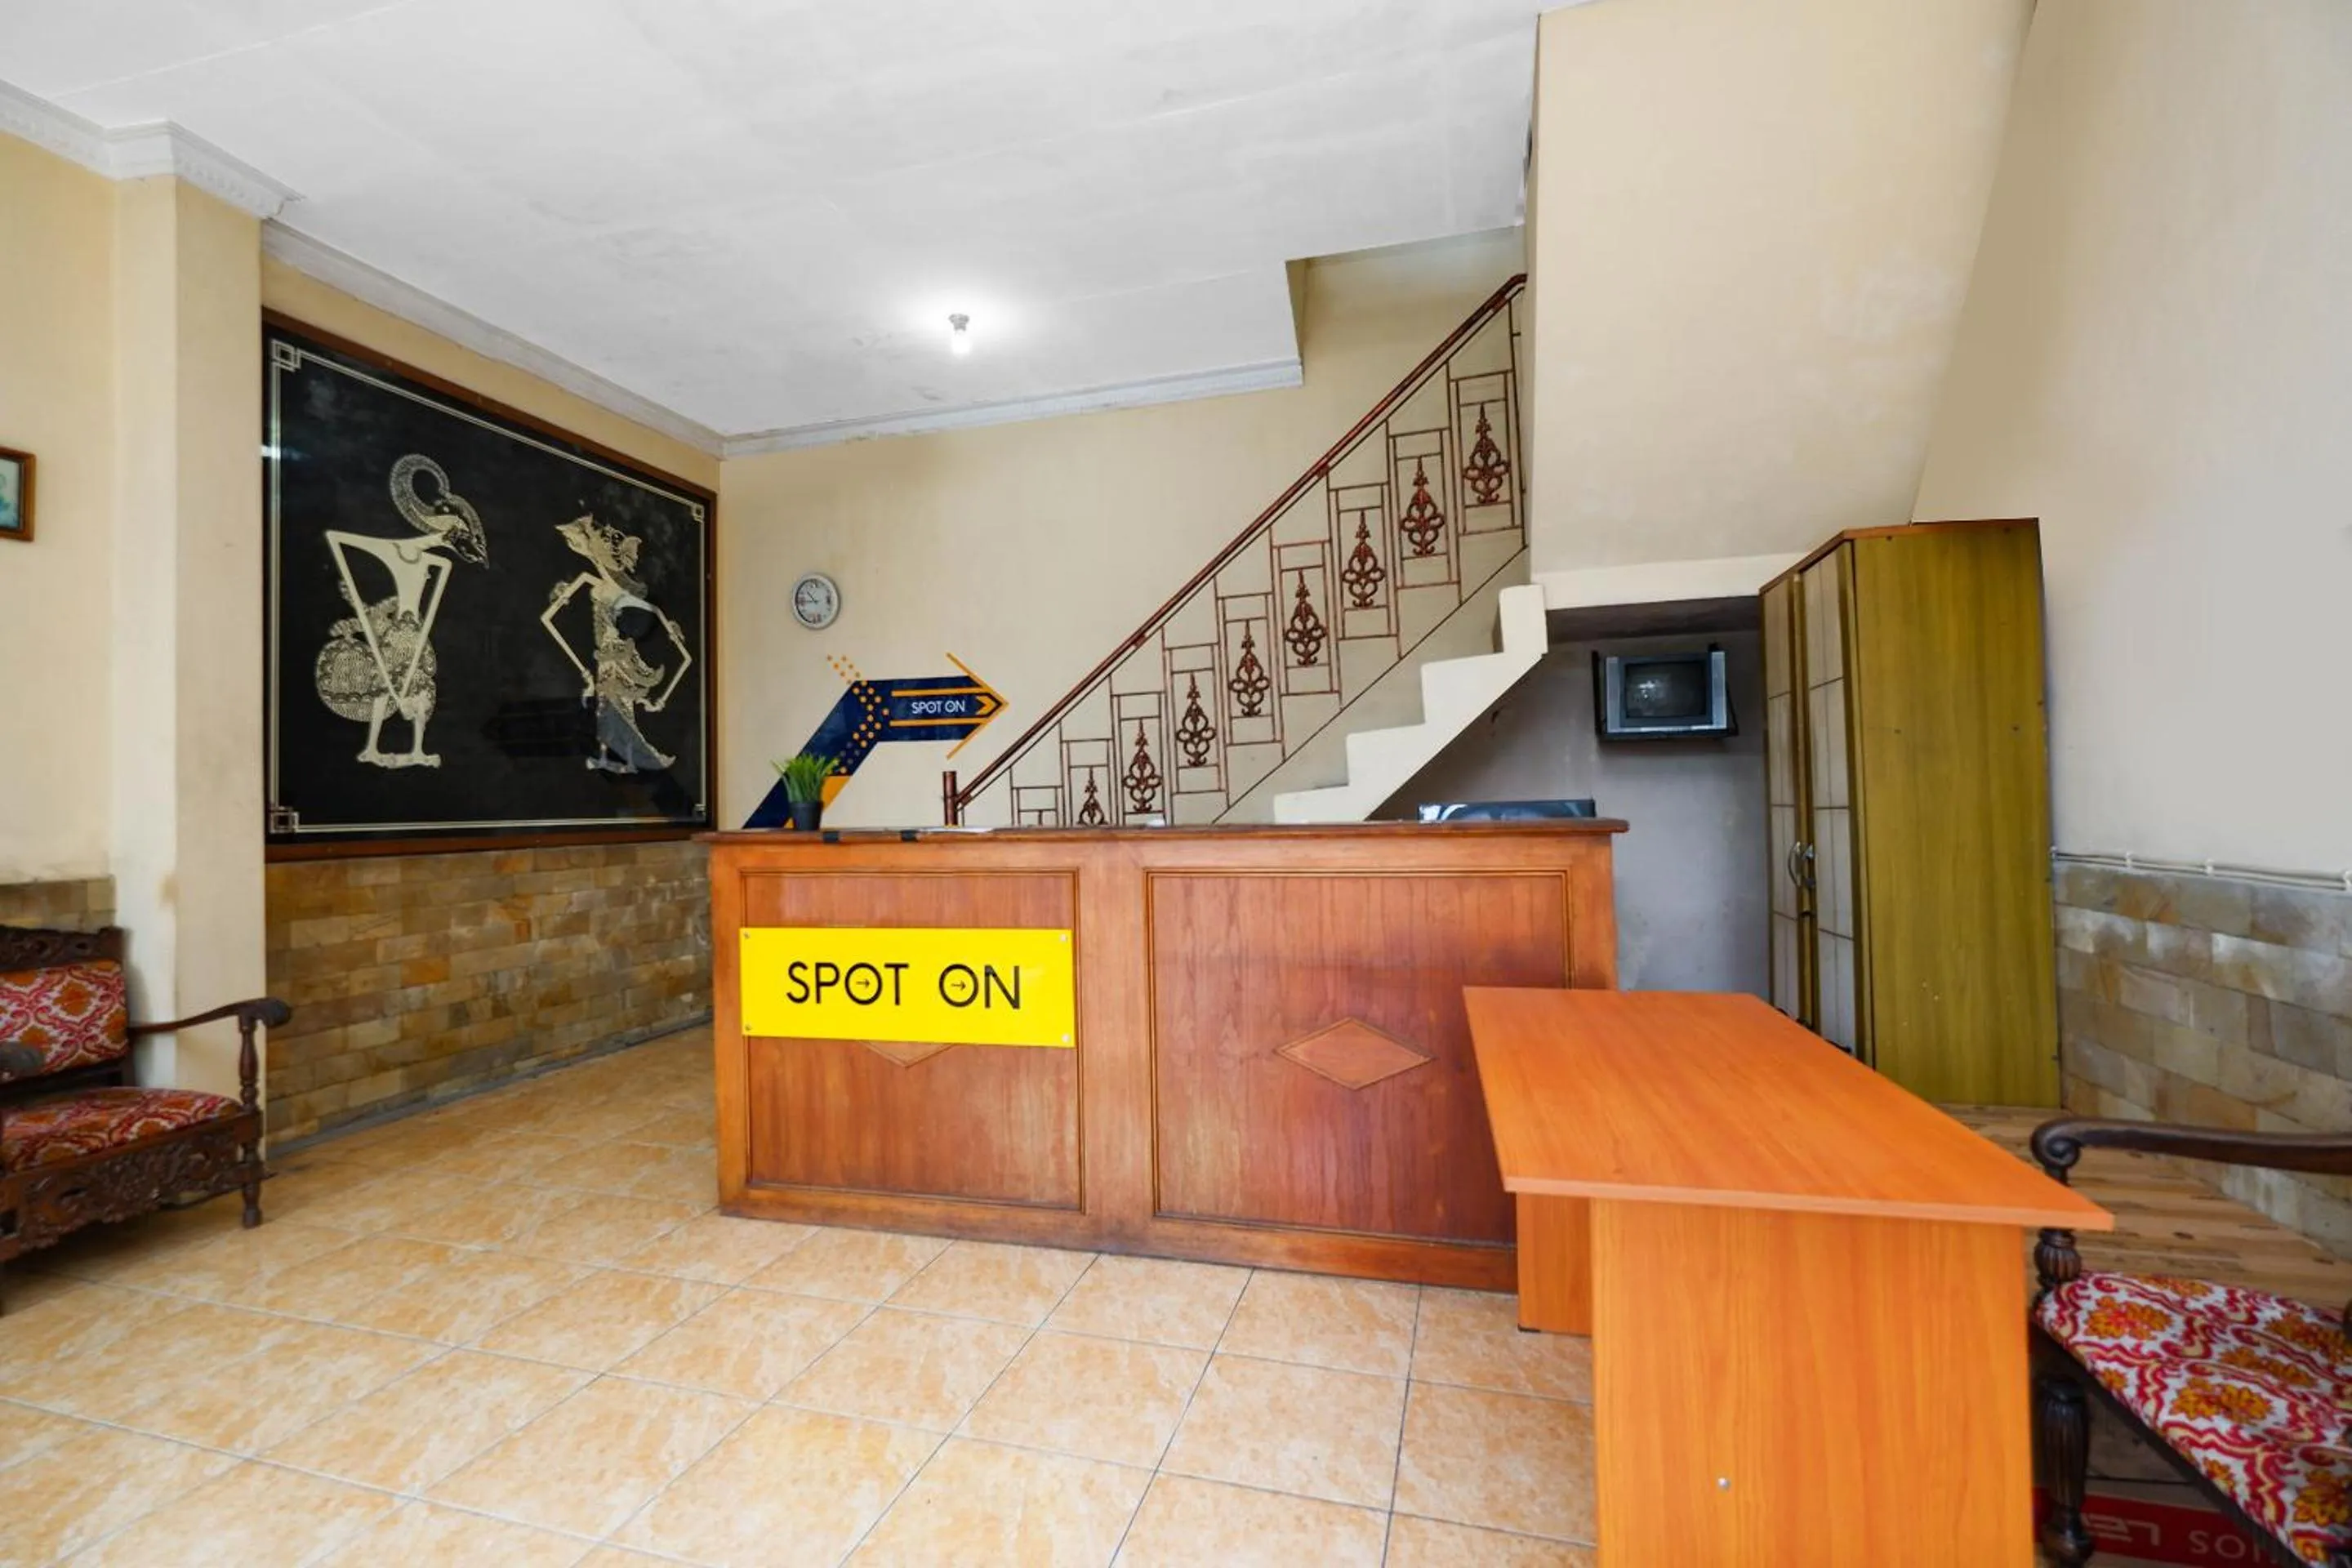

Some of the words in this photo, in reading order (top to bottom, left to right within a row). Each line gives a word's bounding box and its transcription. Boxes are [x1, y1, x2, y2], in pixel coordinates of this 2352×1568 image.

[911, 701, 942, 714] SPOT
[945, 700, 965, 713] ON
[786, 961, 909, 1005] SPOT
[939, 964, 1020, 1009] ON
